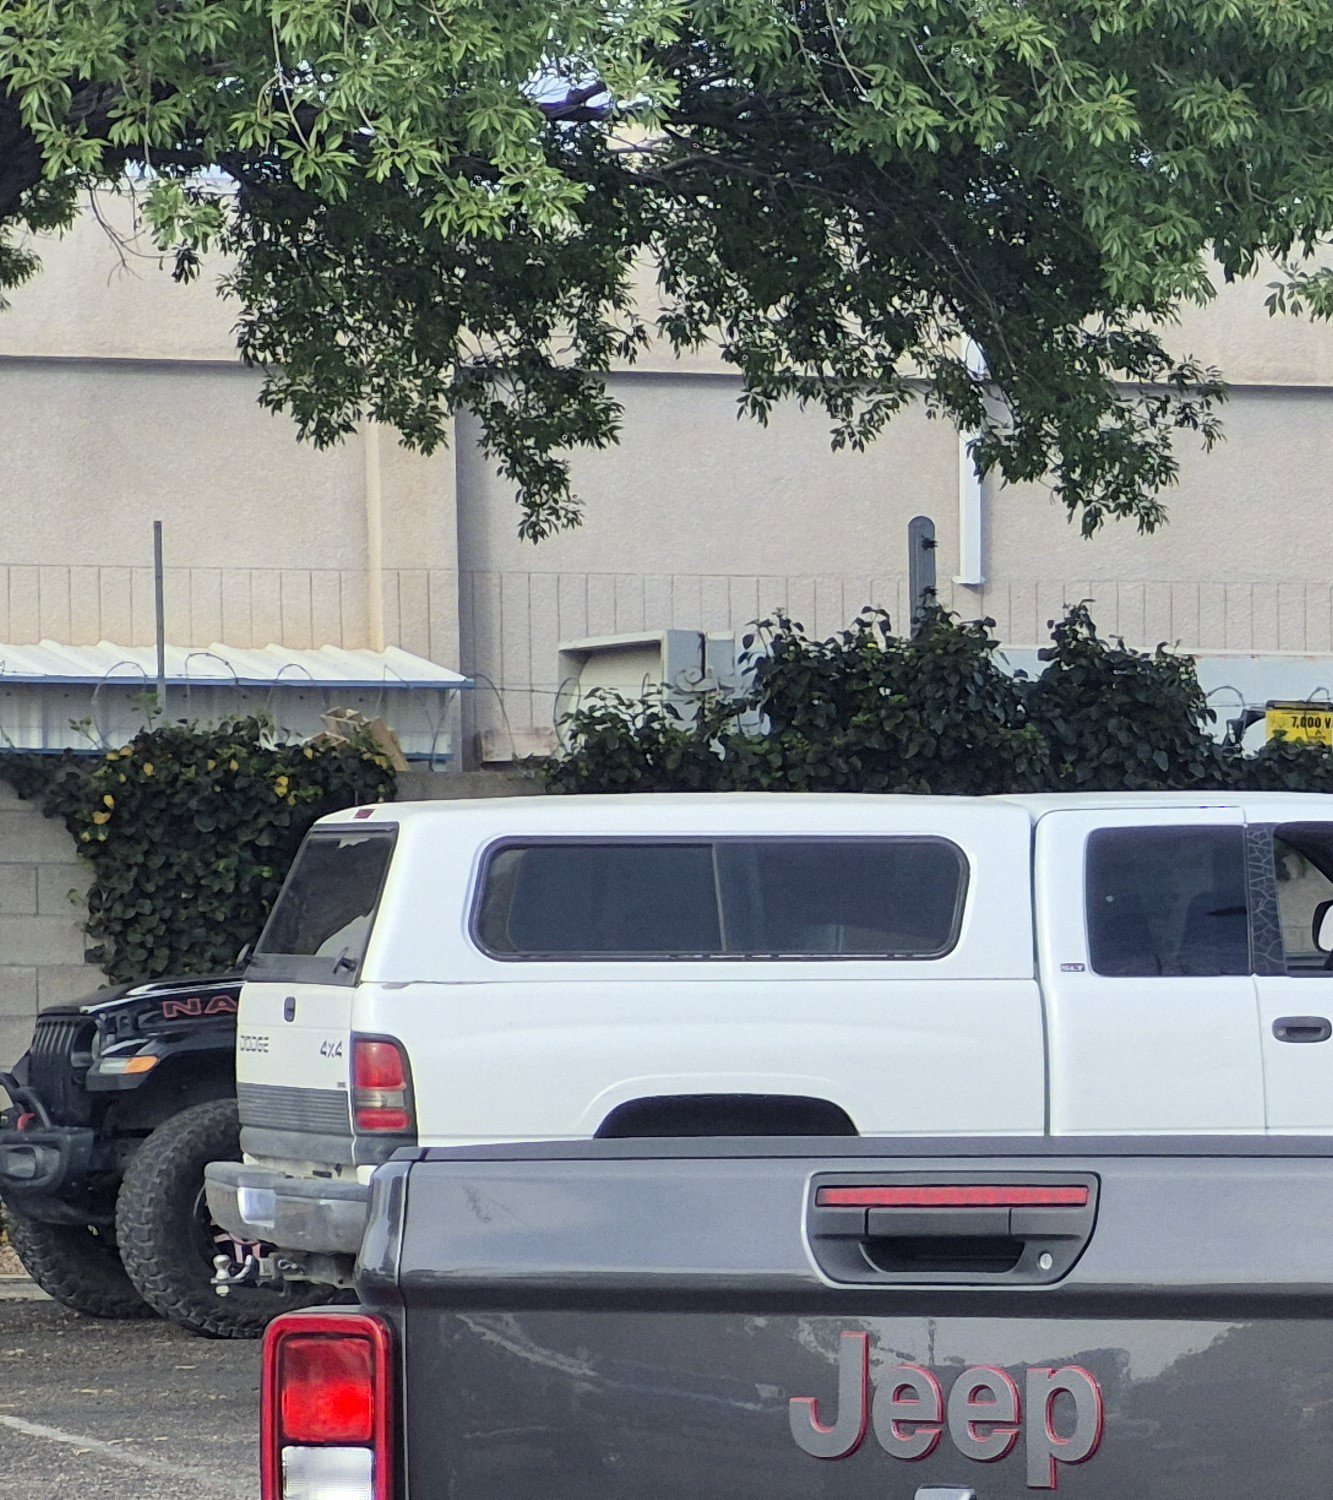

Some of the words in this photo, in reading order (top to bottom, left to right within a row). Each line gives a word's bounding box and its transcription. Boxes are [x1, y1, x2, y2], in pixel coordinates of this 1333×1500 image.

[1290, 716, 1322, 729] 7,000
[1325, 717, 1332, 729] V
[789, 1331, 1105, 1490] Jeep
